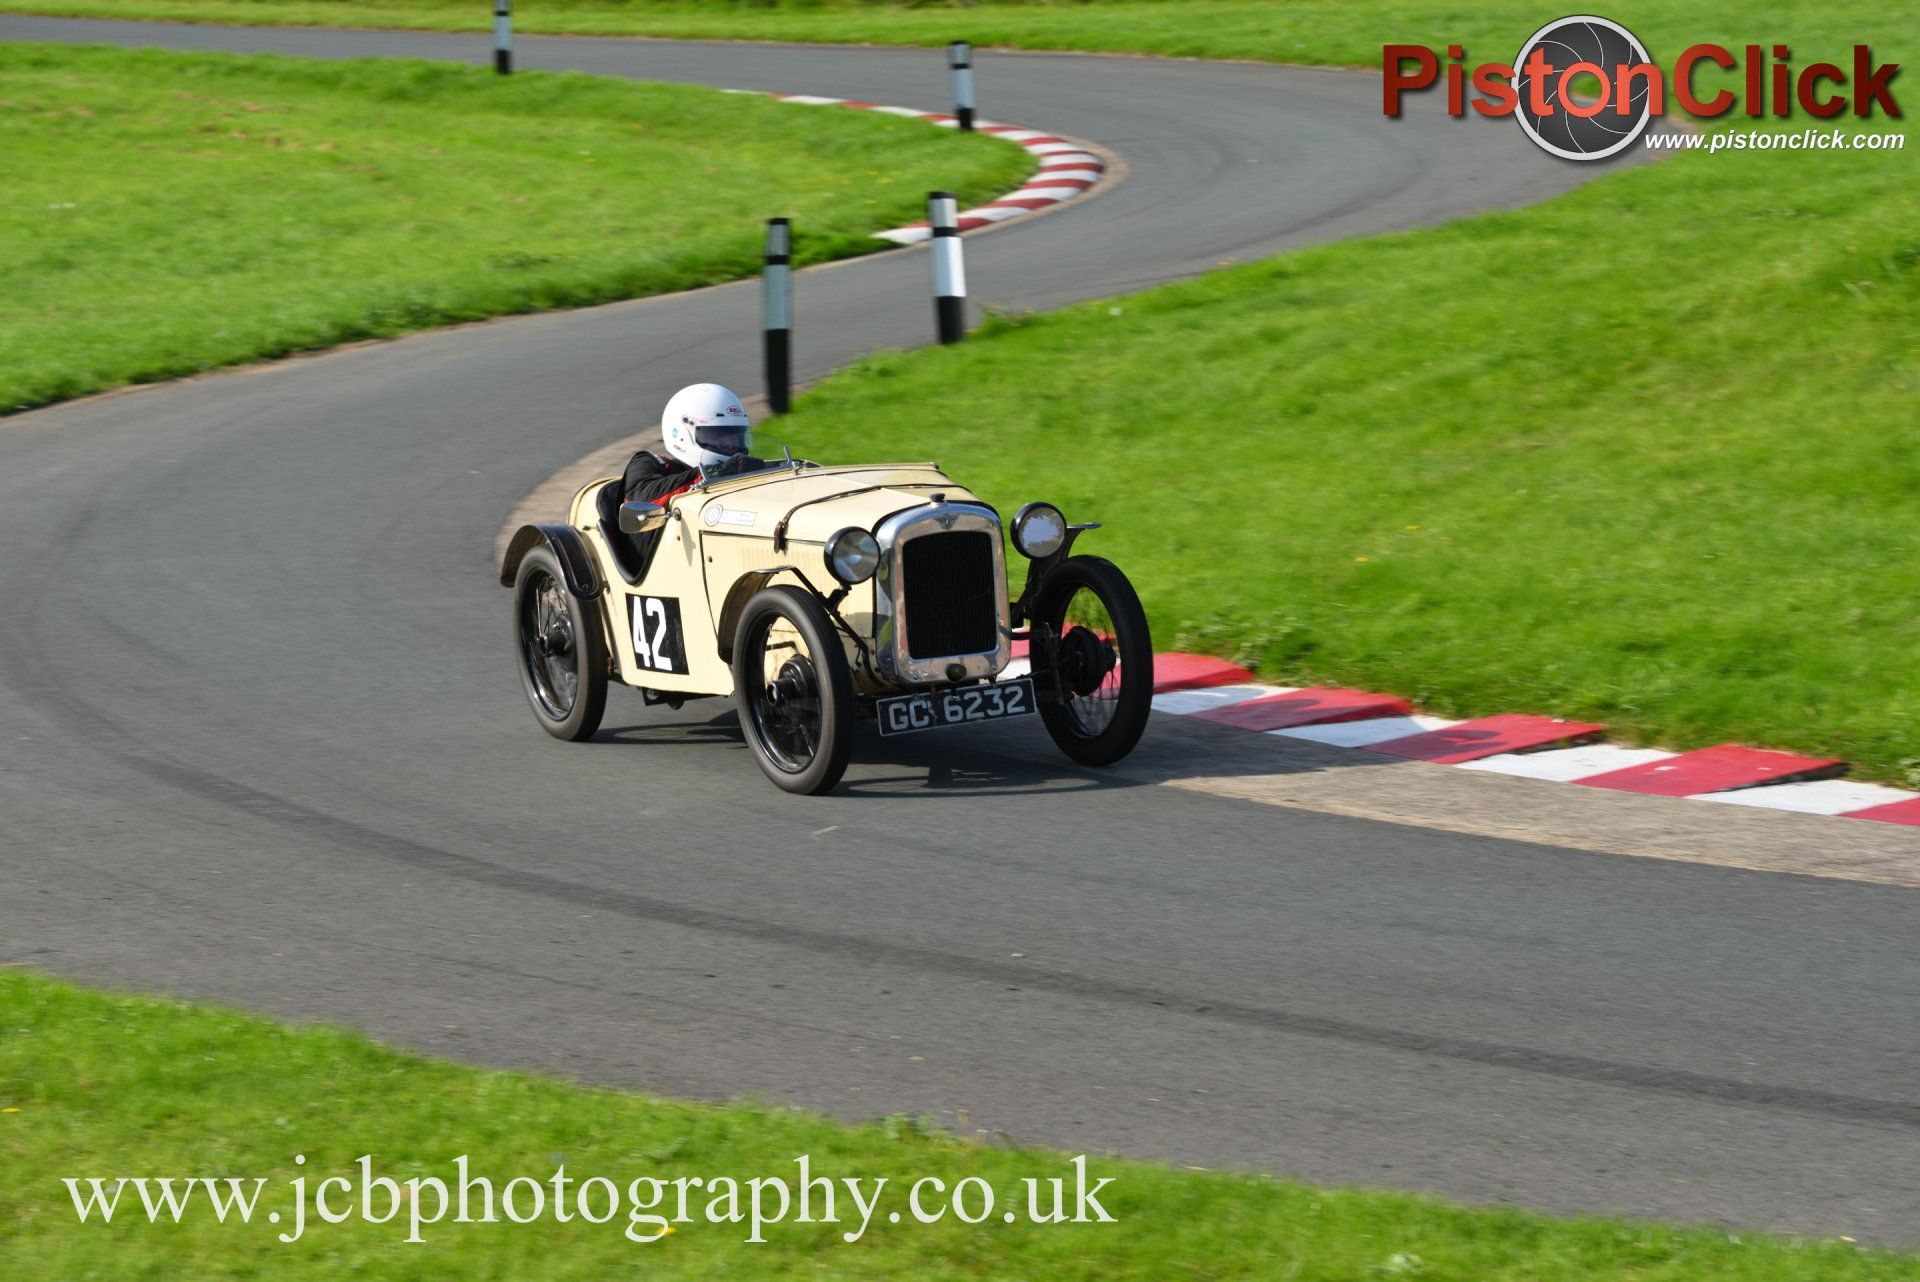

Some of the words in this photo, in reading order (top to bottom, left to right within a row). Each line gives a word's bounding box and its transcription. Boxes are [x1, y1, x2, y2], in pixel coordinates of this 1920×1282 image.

[633, 595, 673, 671] 42
[888, 700, 930, 731] GC
[943, 685, 1026, 723] 6232
